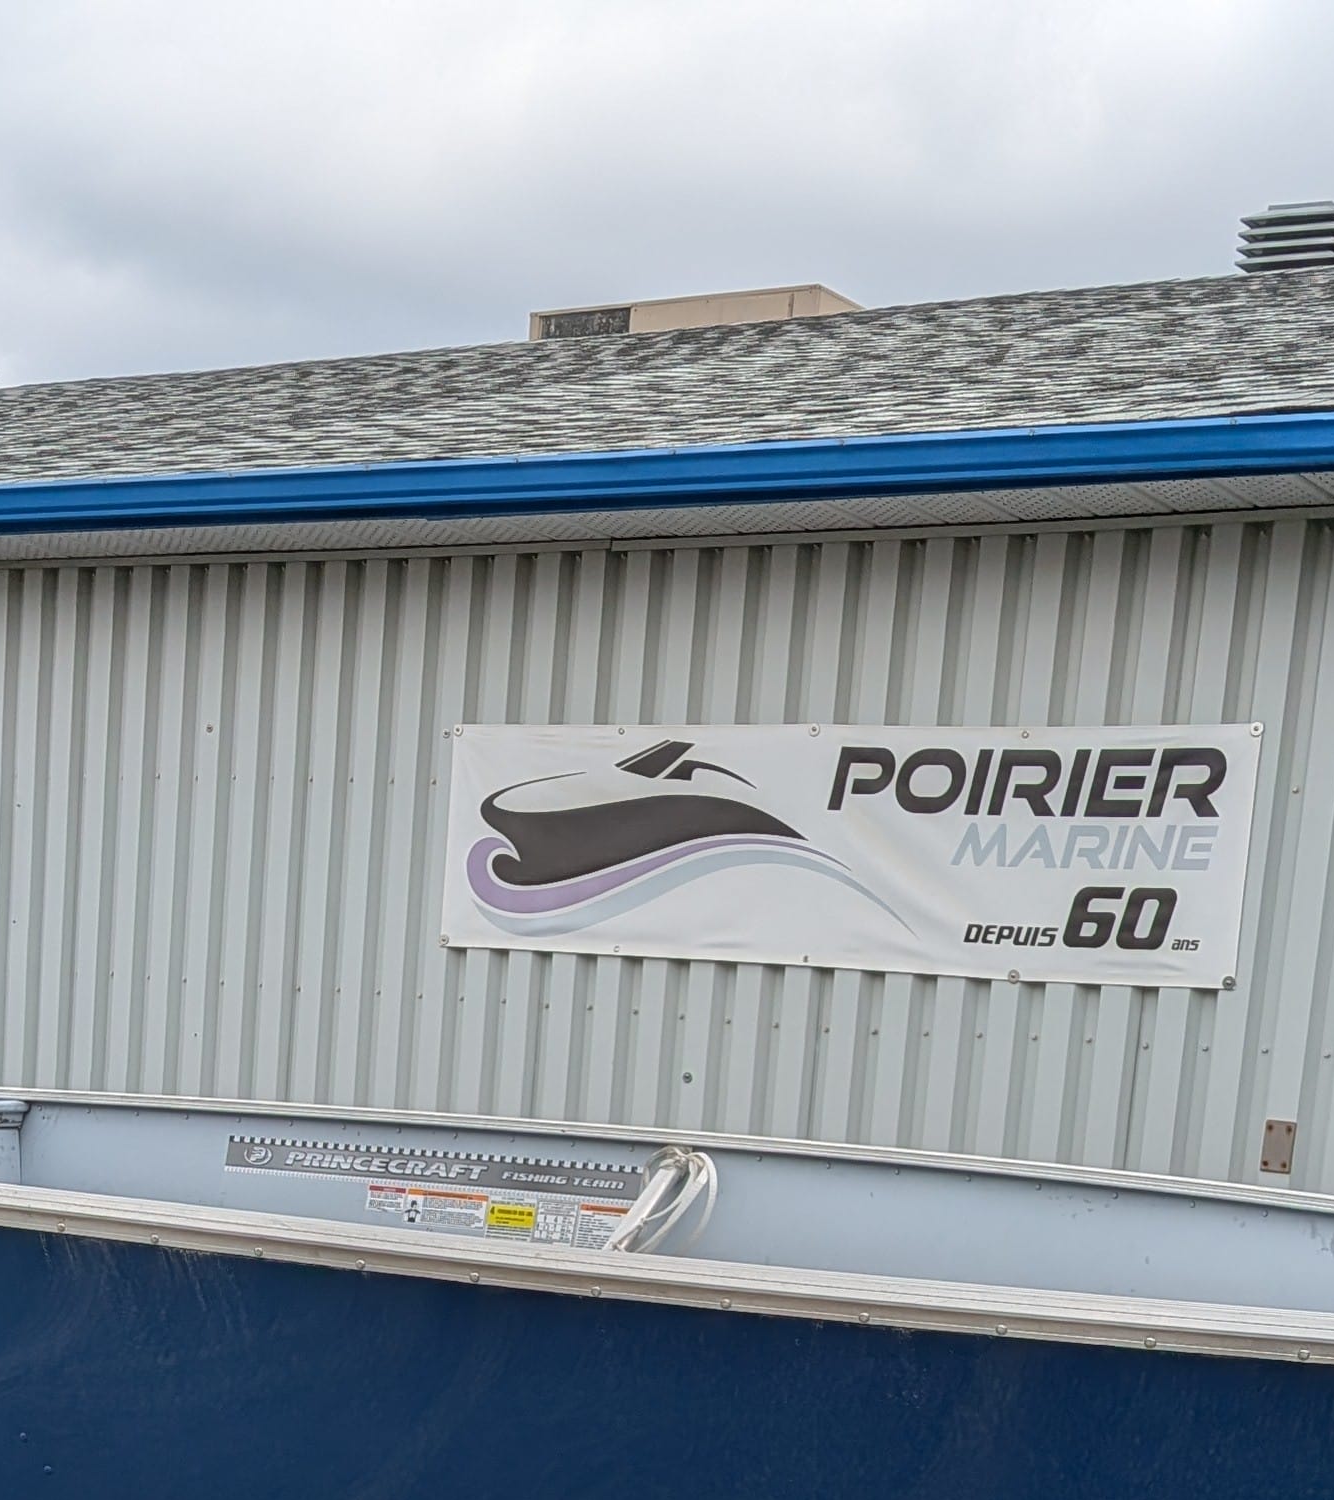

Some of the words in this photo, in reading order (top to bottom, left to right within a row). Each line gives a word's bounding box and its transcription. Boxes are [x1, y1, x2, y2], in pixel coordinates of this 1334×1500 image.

[827, 746, 1228, 818] POIRIER
[950, 823, 1219, 871] MARINE
[963, 923, 1058, 948] DEPUIS
[1062, 886, 1178, 950] 60
[1172, 937, 1200, 952] ans
[285, 1150, 488, 1181] PRINCECRAFT
